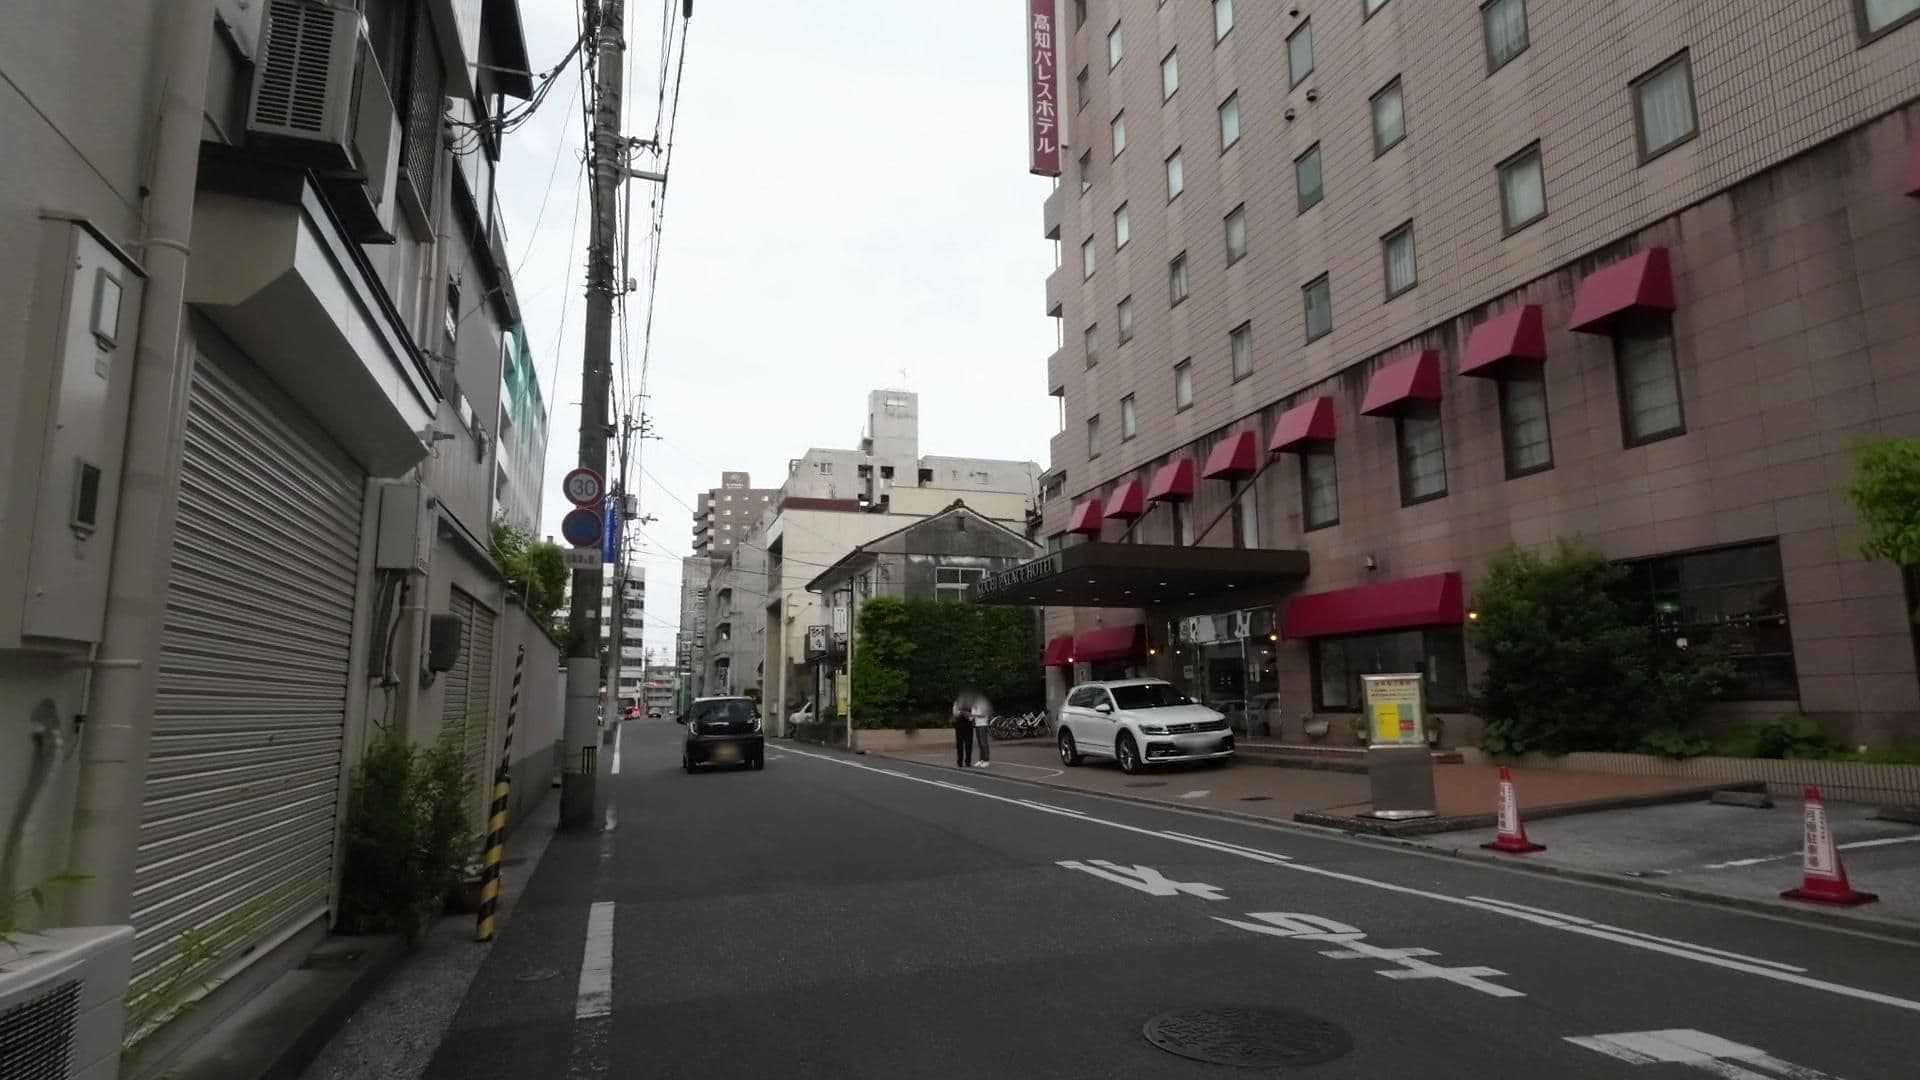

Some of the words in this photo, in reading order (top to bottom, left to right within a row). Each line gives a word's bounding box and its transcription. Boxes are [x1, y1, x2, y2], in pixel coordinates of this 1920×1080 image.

[1033, 13, 1056, 154] 高知パレスホテル
[573, 479, 596, 496] 30
[1027, 559, 1052, 578] HOTEL
